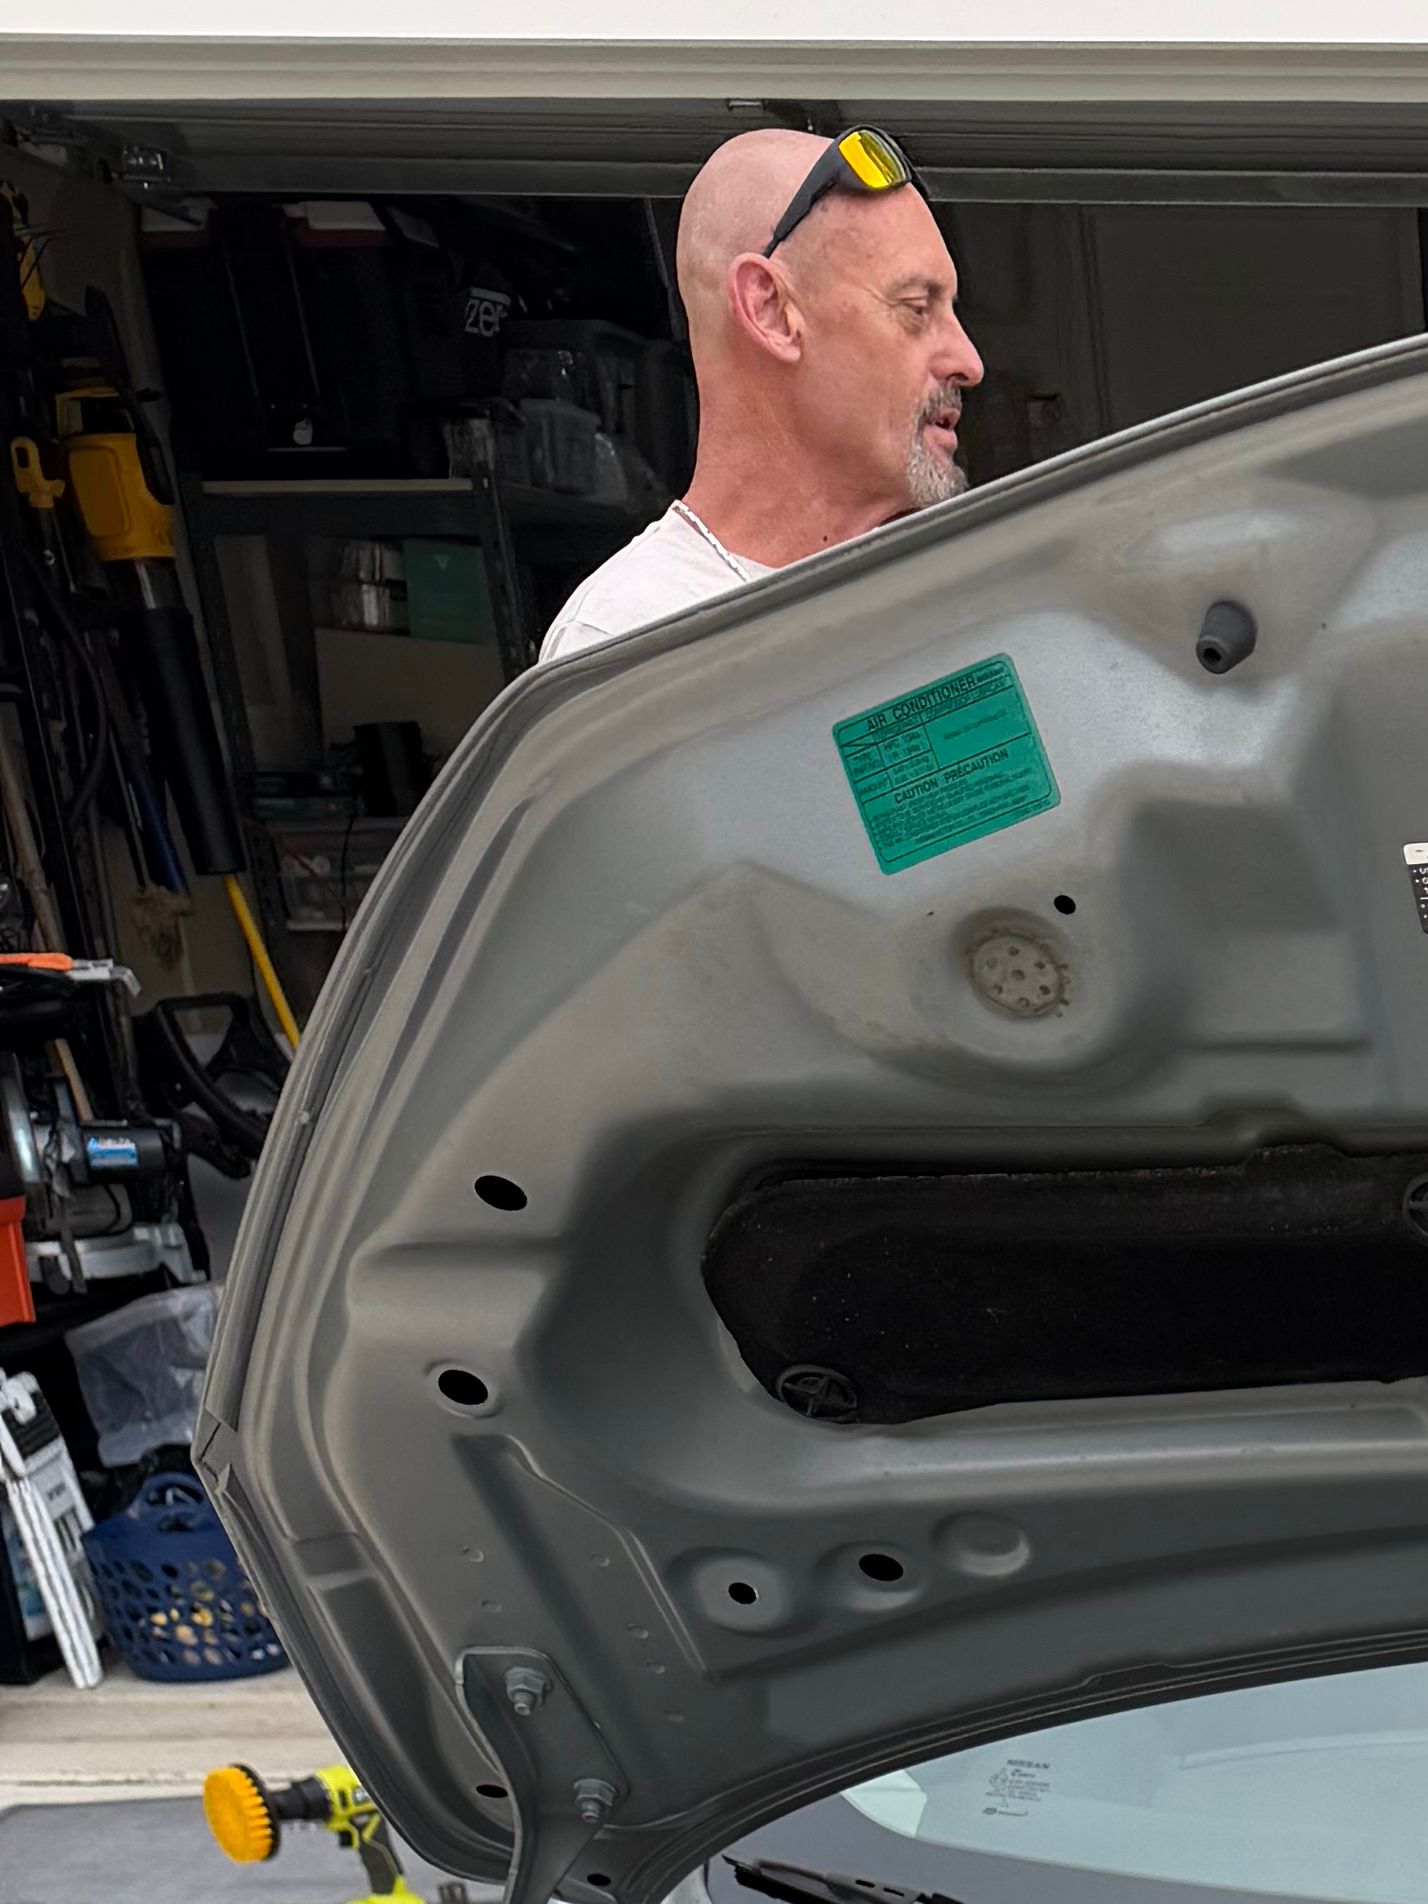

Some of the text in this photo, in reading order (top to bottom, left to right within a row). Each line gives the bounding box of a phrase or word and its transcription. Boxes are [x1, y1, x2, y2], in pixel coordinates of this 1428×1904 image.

[868, 714, 887, 731] AIR
[894, 674, 976, 720] CONDITIONER
[895, 779, 938, 804] CAUTION
